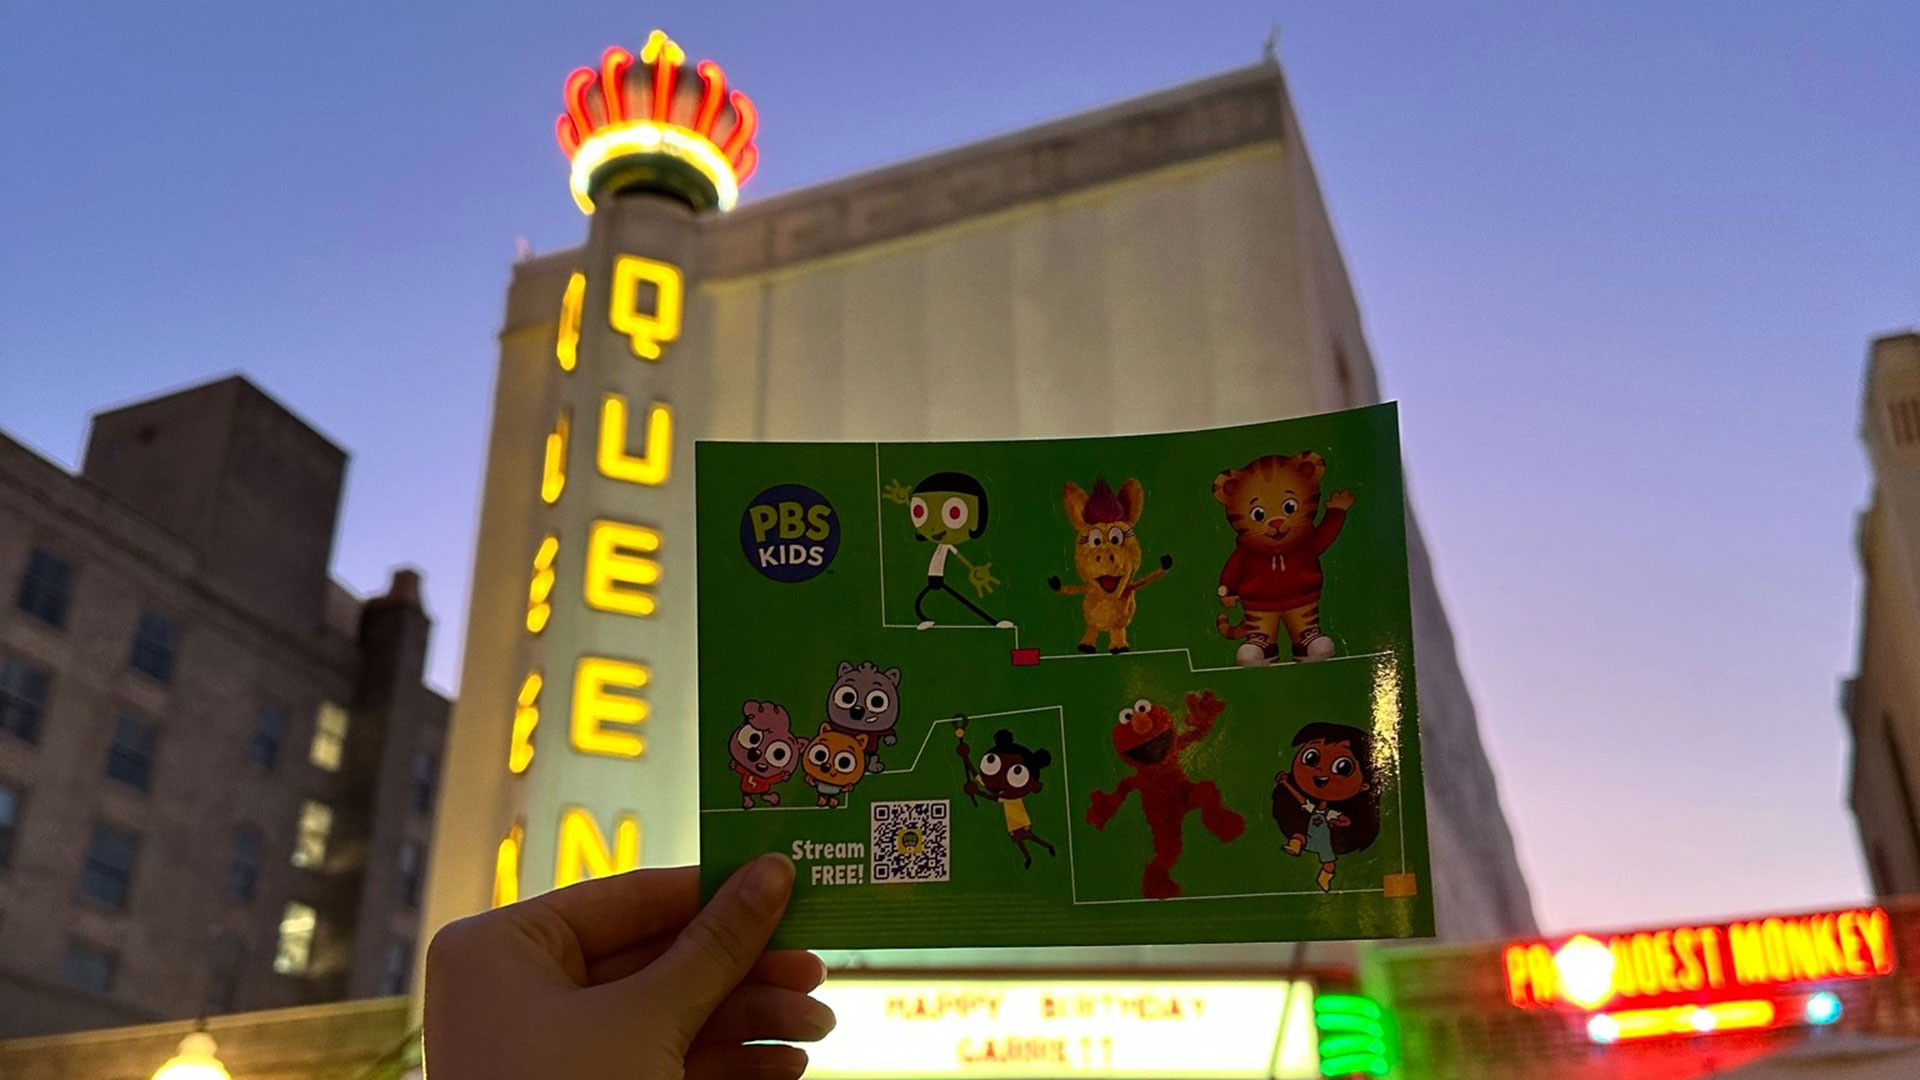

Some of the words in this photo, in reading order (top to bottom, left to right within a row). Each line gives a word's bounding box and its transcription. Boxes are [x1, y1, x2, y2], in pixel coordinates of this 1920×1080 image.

[749, 501, 832, 543] PBS
[758, 544, 825, 568] KIDS
[556, 254, 683, 887] QUEEN
[792, 839, 865, 860] Stream
[811, 864, 864, 886] FREE!
[1729, 908, 1891, 986] MONKEY
[885, 994, 1001, 1020] HAPPY
